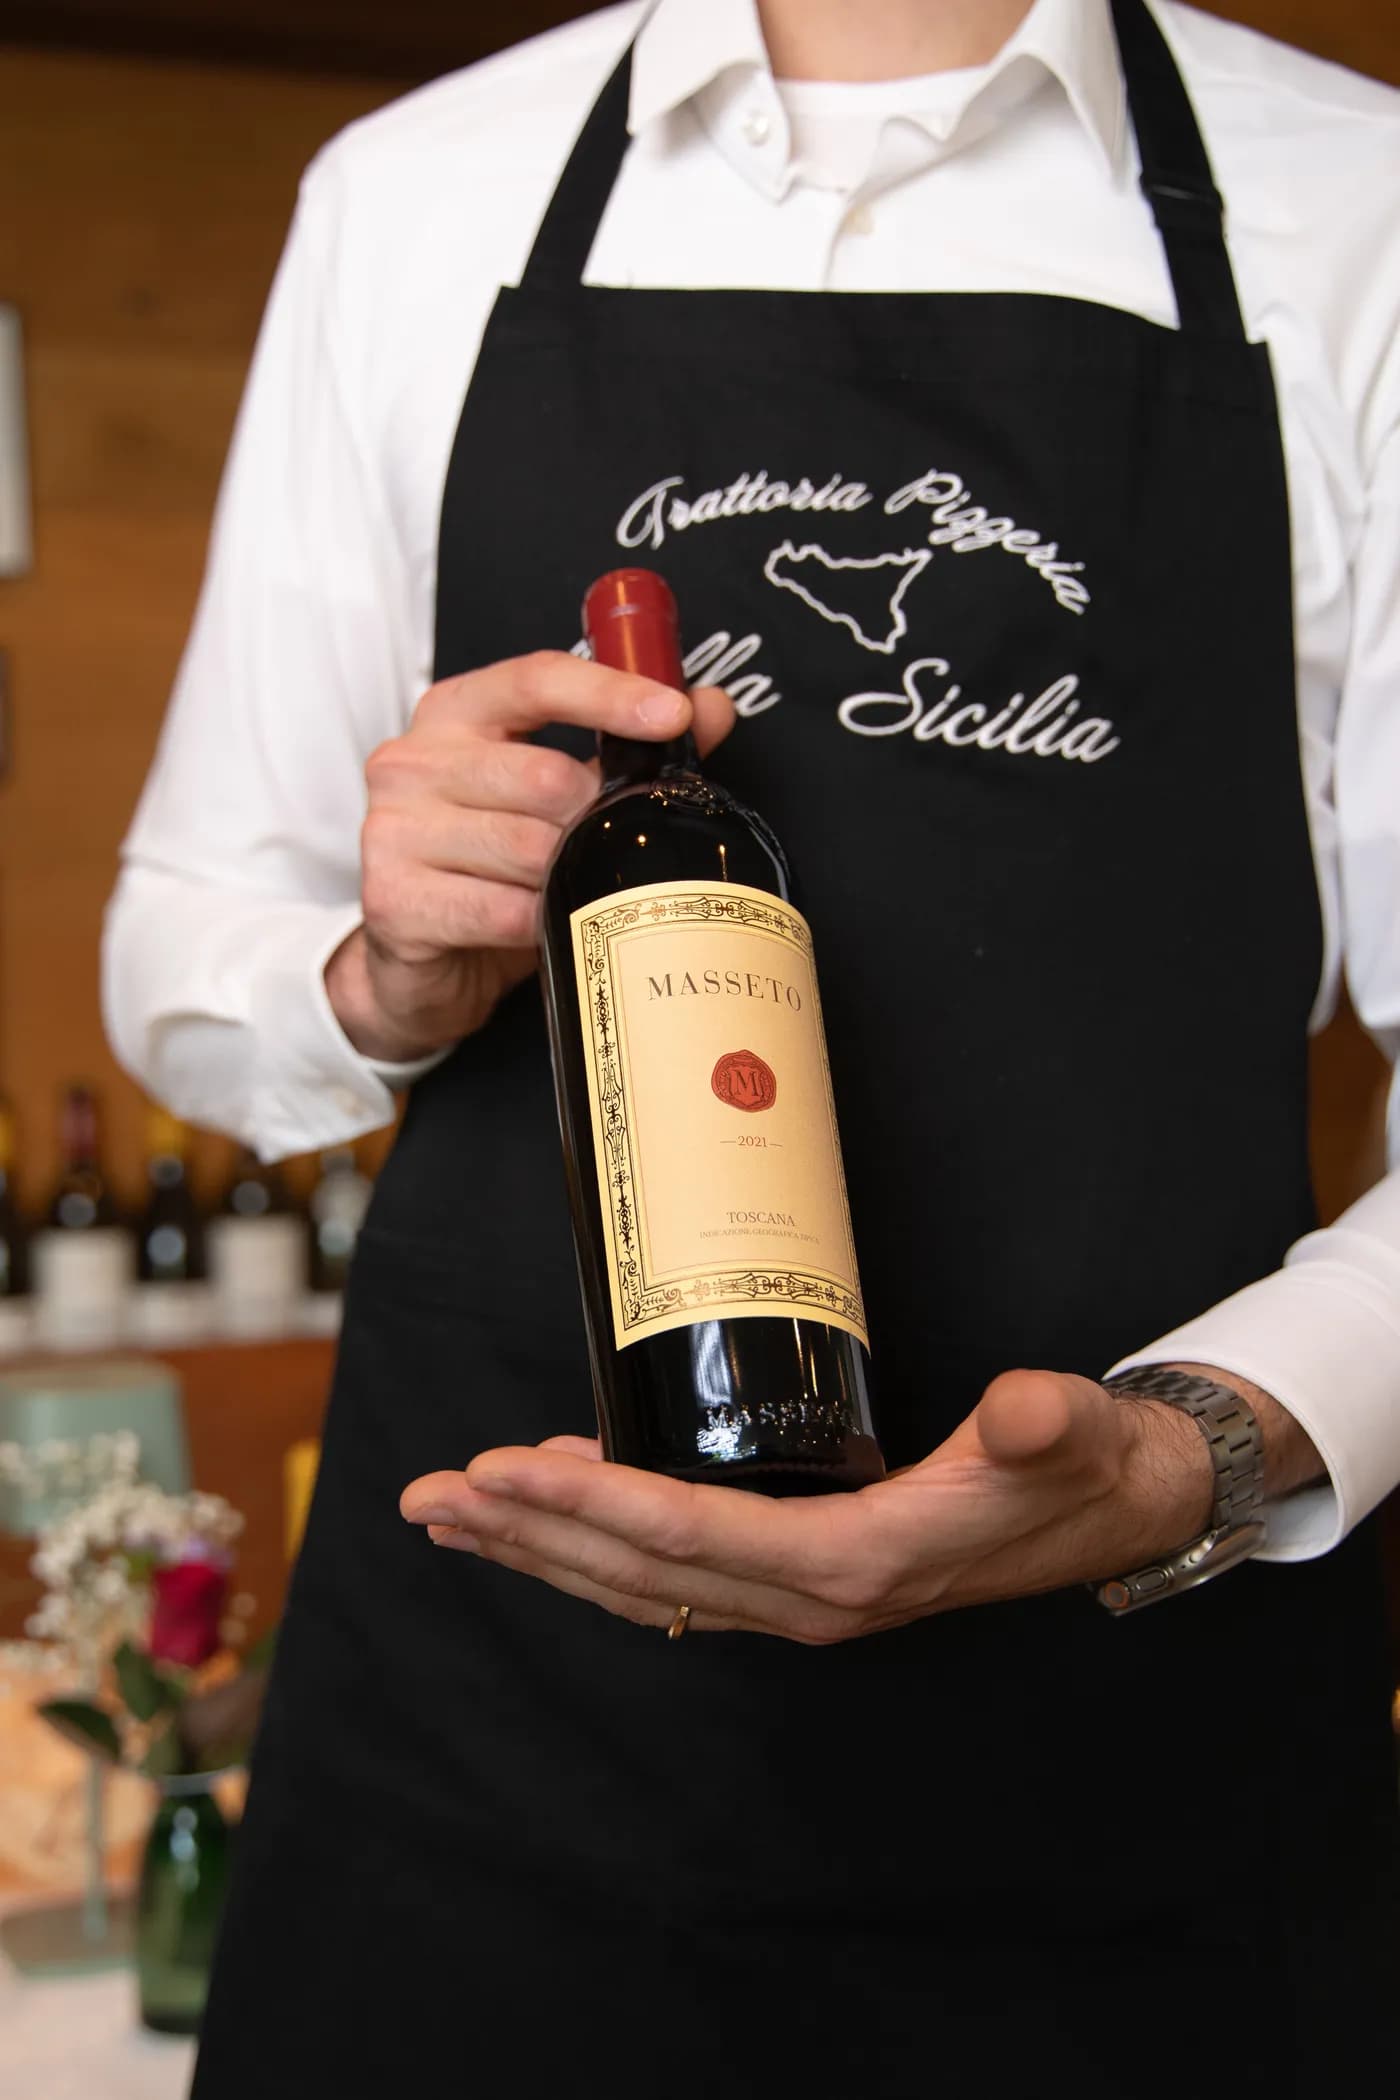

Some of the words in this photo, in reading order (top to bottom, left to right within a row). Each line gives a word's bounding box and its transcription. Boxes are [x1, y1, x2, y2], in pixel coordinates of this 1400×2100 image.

[616, 470, 874, 550] Trattoria
[884, 467, 1091, 615] Pizzeria
[838, 657, 1121, 762] Sicilia
[647, 969, 802, 1012] MASSETO
[725, 1211, 796, 1227] TOSCANA
